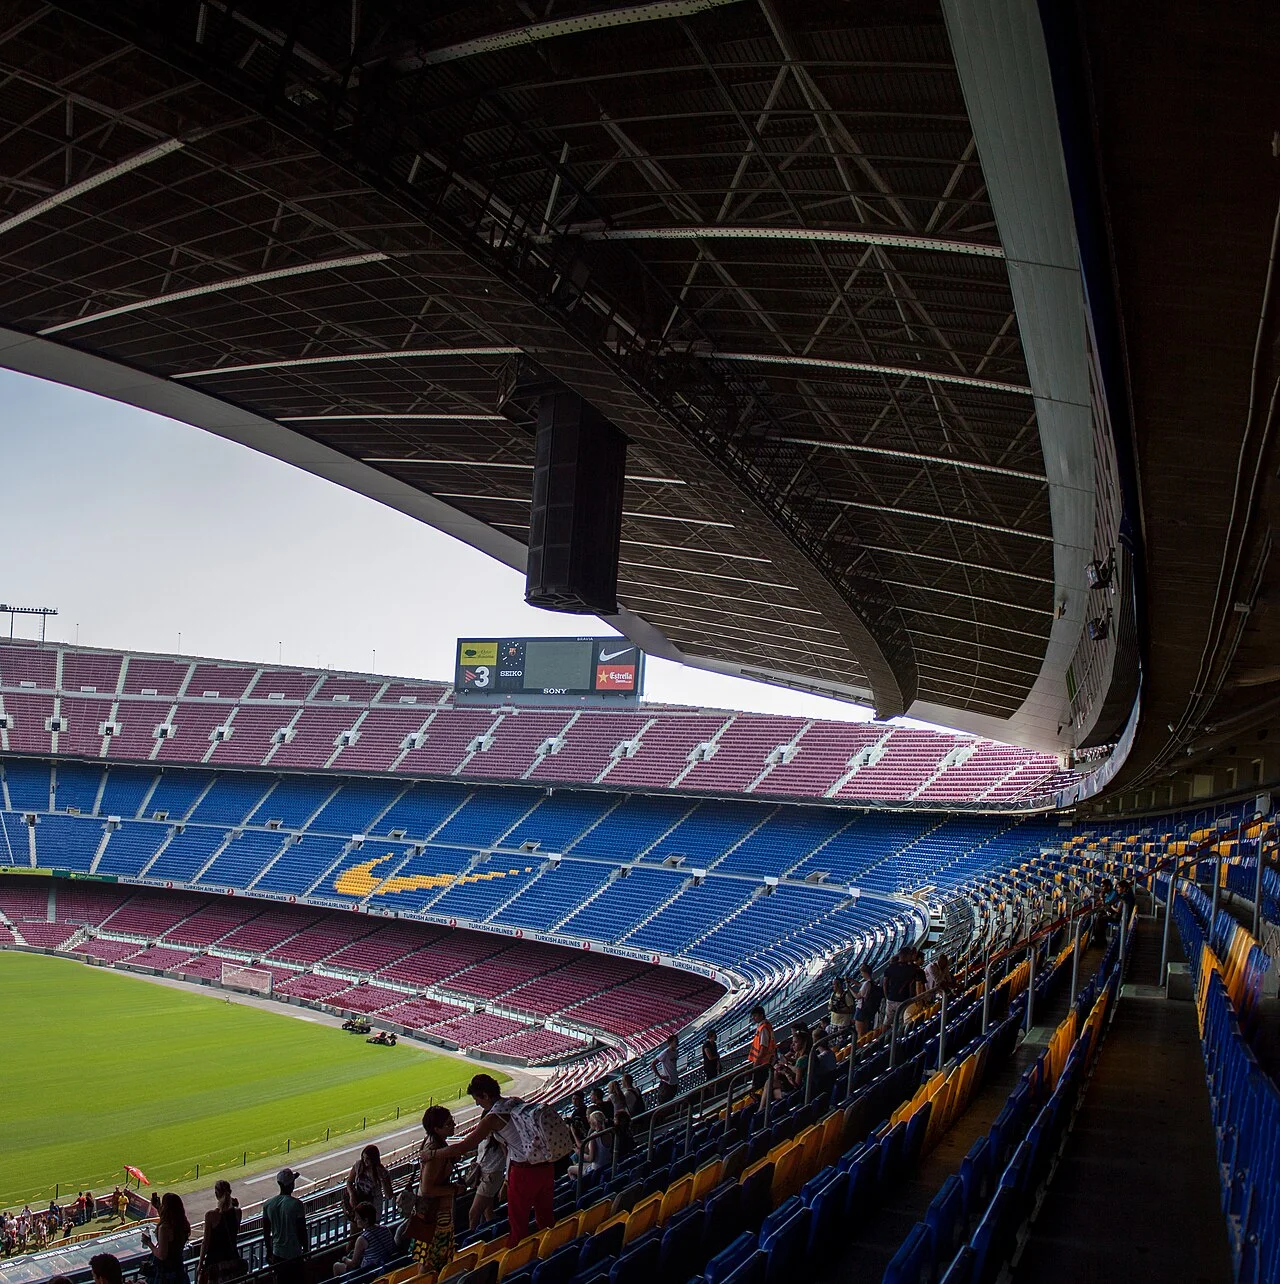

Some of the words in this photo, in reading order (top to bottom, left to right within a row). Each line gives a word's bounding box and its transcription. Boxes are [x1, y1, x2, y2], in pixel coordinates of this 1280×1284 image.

[474, 666, 490, 687] 3
[609, 671, 632, 679] Estrella
[329, 902, 350, 910] AIRLINES
[425, 916, 447, 924] AIRLINES
[468, 922, 490, 930] TURKISH
[491, 926, 513, 935] AIRLINES
[535, 934, 557, 943] TURKISH
[557, 938, 581, 947] AIRLINES
[603, 946, 626, 956] TURKISH
[626, 951, 649, 961] AIRLINES
